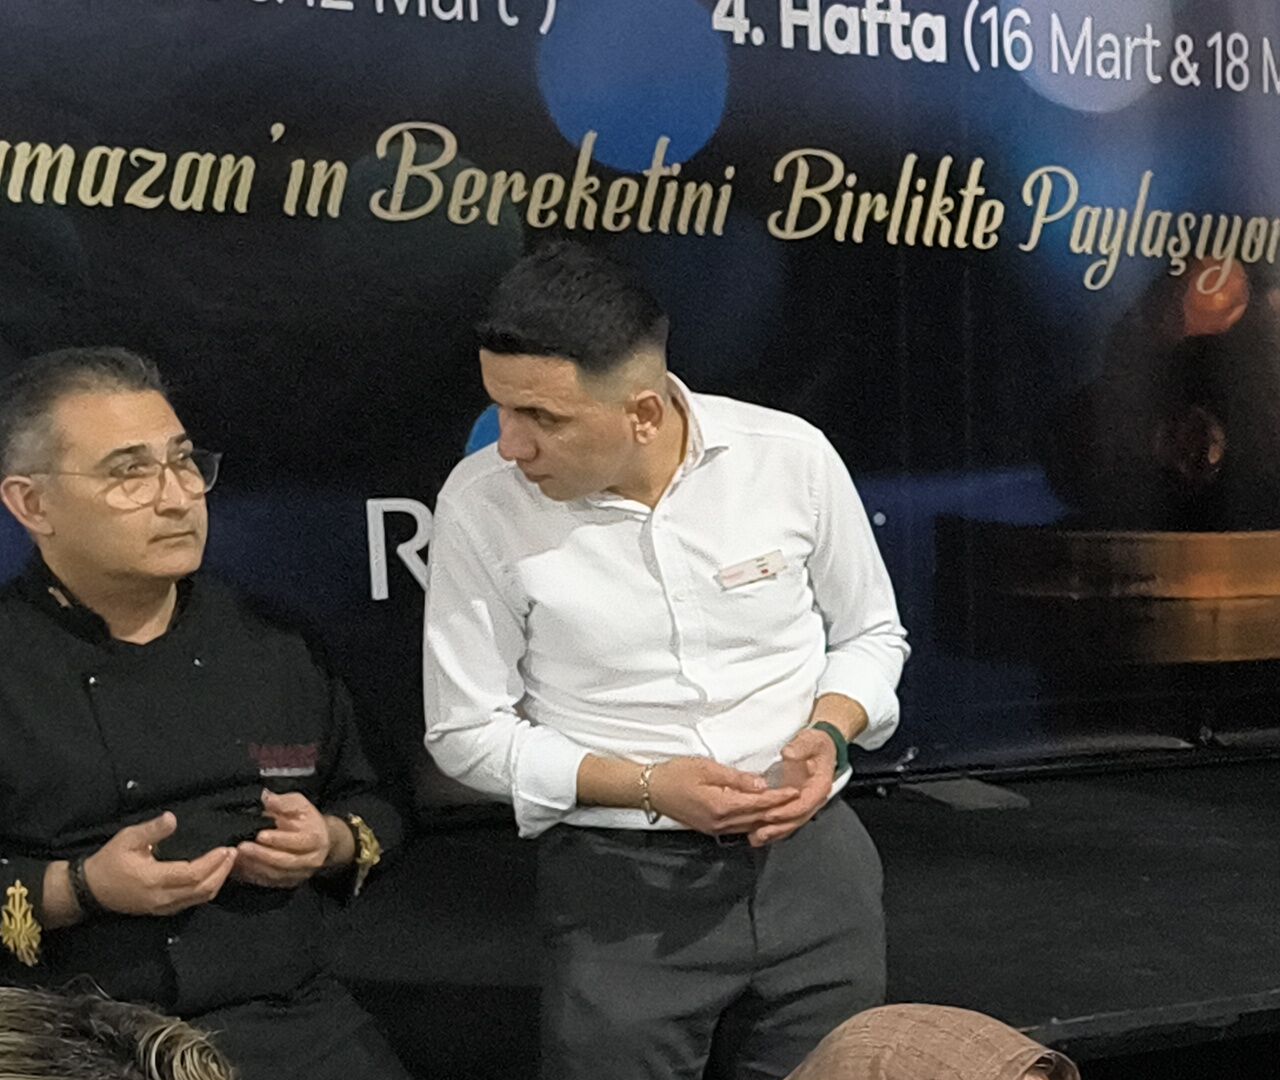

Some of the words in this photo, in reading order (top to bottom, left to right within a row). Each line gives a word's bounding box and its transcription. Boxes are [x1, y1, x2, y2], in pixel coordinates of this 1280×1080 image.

[712, 0, 765, 46] 4.
[779, 0, 948, 63] Hafta
[963, 0, 1034, 72] (16
[1050, 12, 1162, 84] Mart
[0, 122, 349, 219] mazan'ın
[369, 120, 735, 237] Bereketini
[767, 147, 1004, 250] Birlikte
